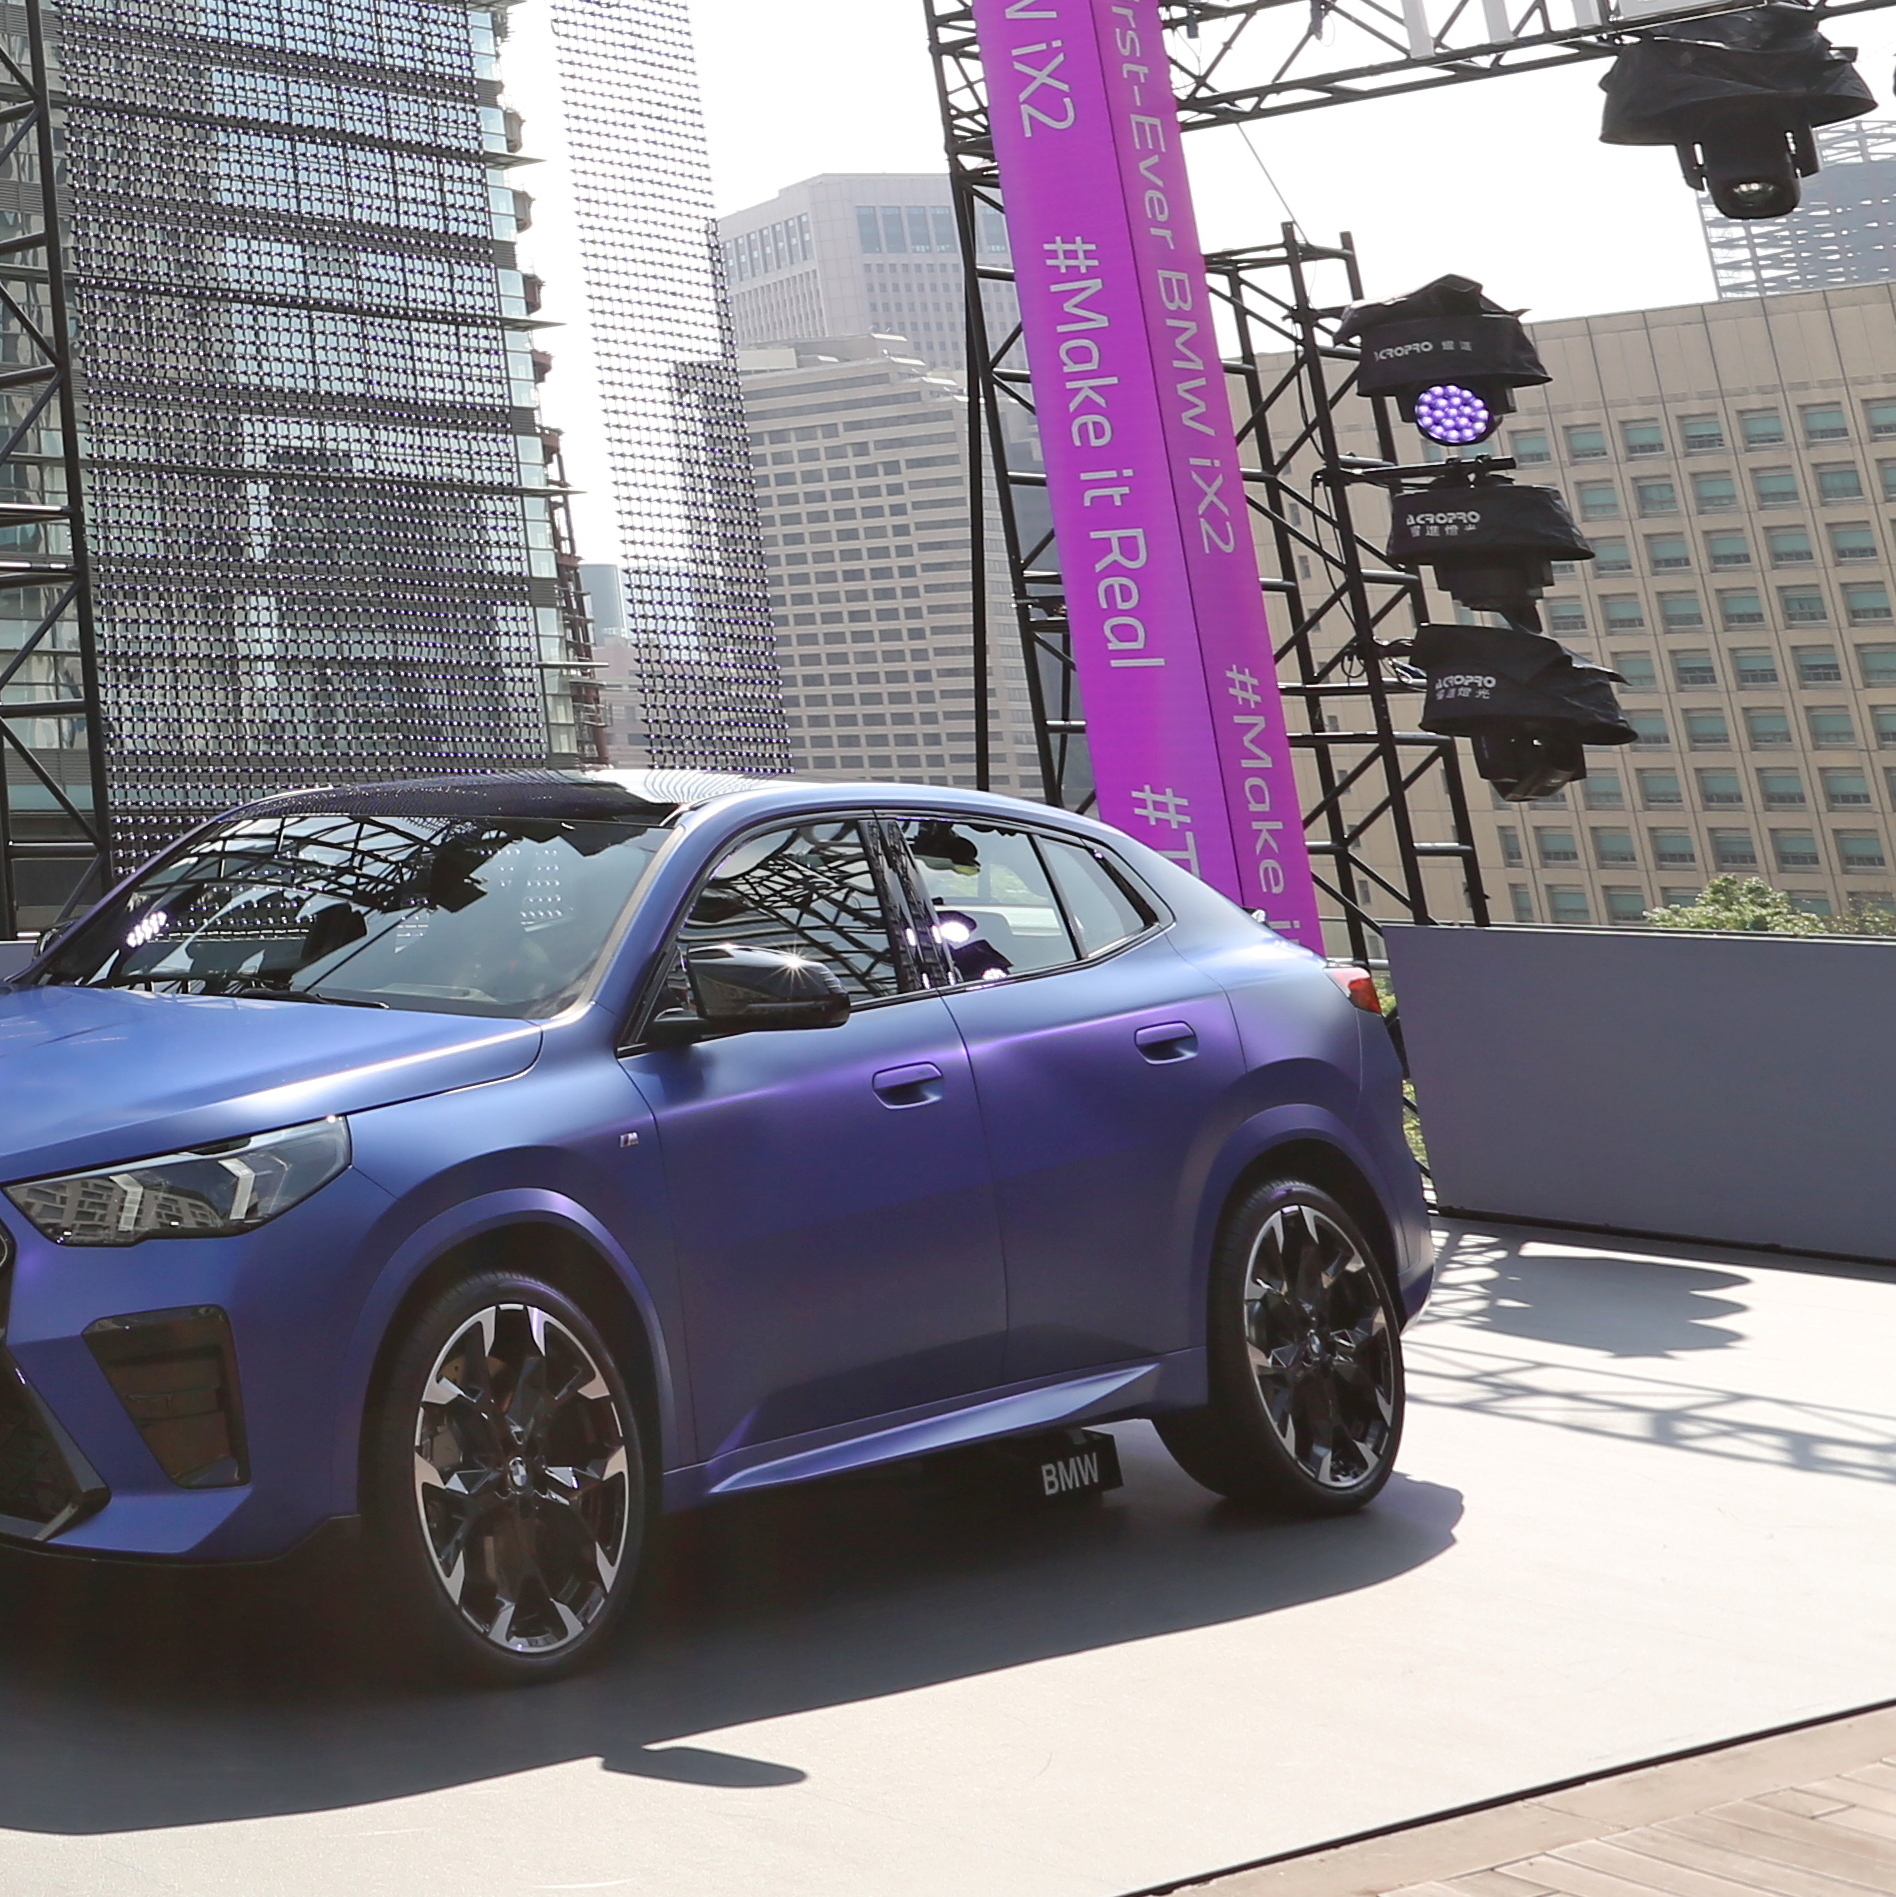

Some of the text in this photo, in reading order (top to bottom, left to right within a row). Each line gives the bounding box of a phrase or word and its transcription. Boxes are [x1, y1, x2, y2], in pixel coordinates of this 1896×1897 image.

[1010, 40, 1076, 138] iX2
[1043, 235, 1166, 668] #Make it Real
[1157, 269, 1215, 437] BMW
[1189, 457, 1236, 554] iX2
[1225, 663, 1301, 945] #Make i
[1041, 1452, 1099, 1496] BMW
